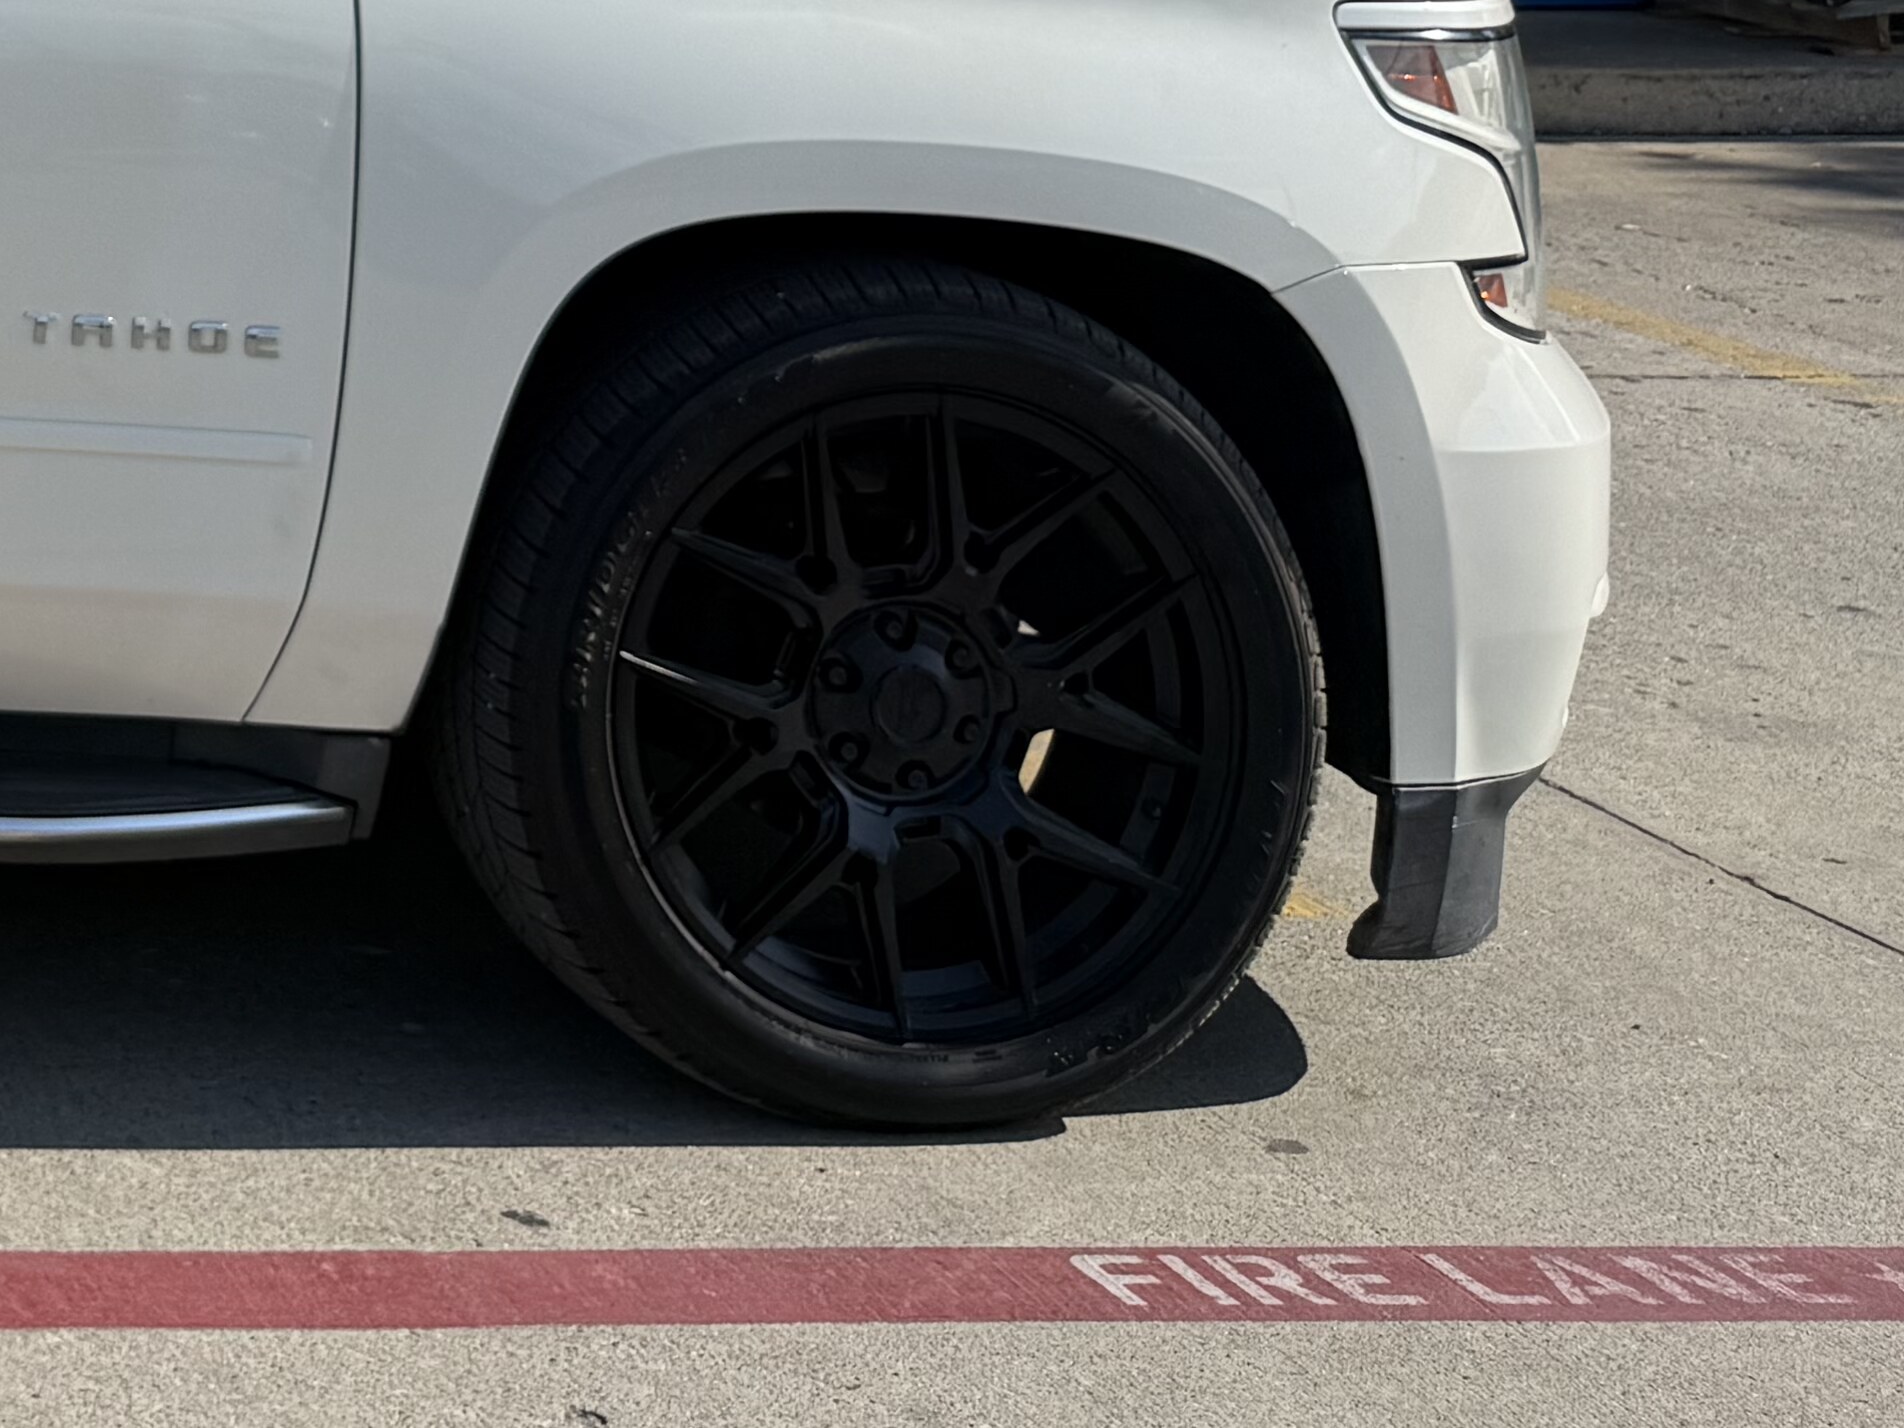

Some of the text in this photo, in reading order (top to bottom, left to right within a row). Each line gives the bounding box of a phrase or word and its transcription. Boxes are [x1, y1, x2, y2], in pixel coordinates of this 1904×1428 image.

[22, 309, 283, 360] TAHOE
[1068, 1252, 1859, 1306] FIRE LANE
